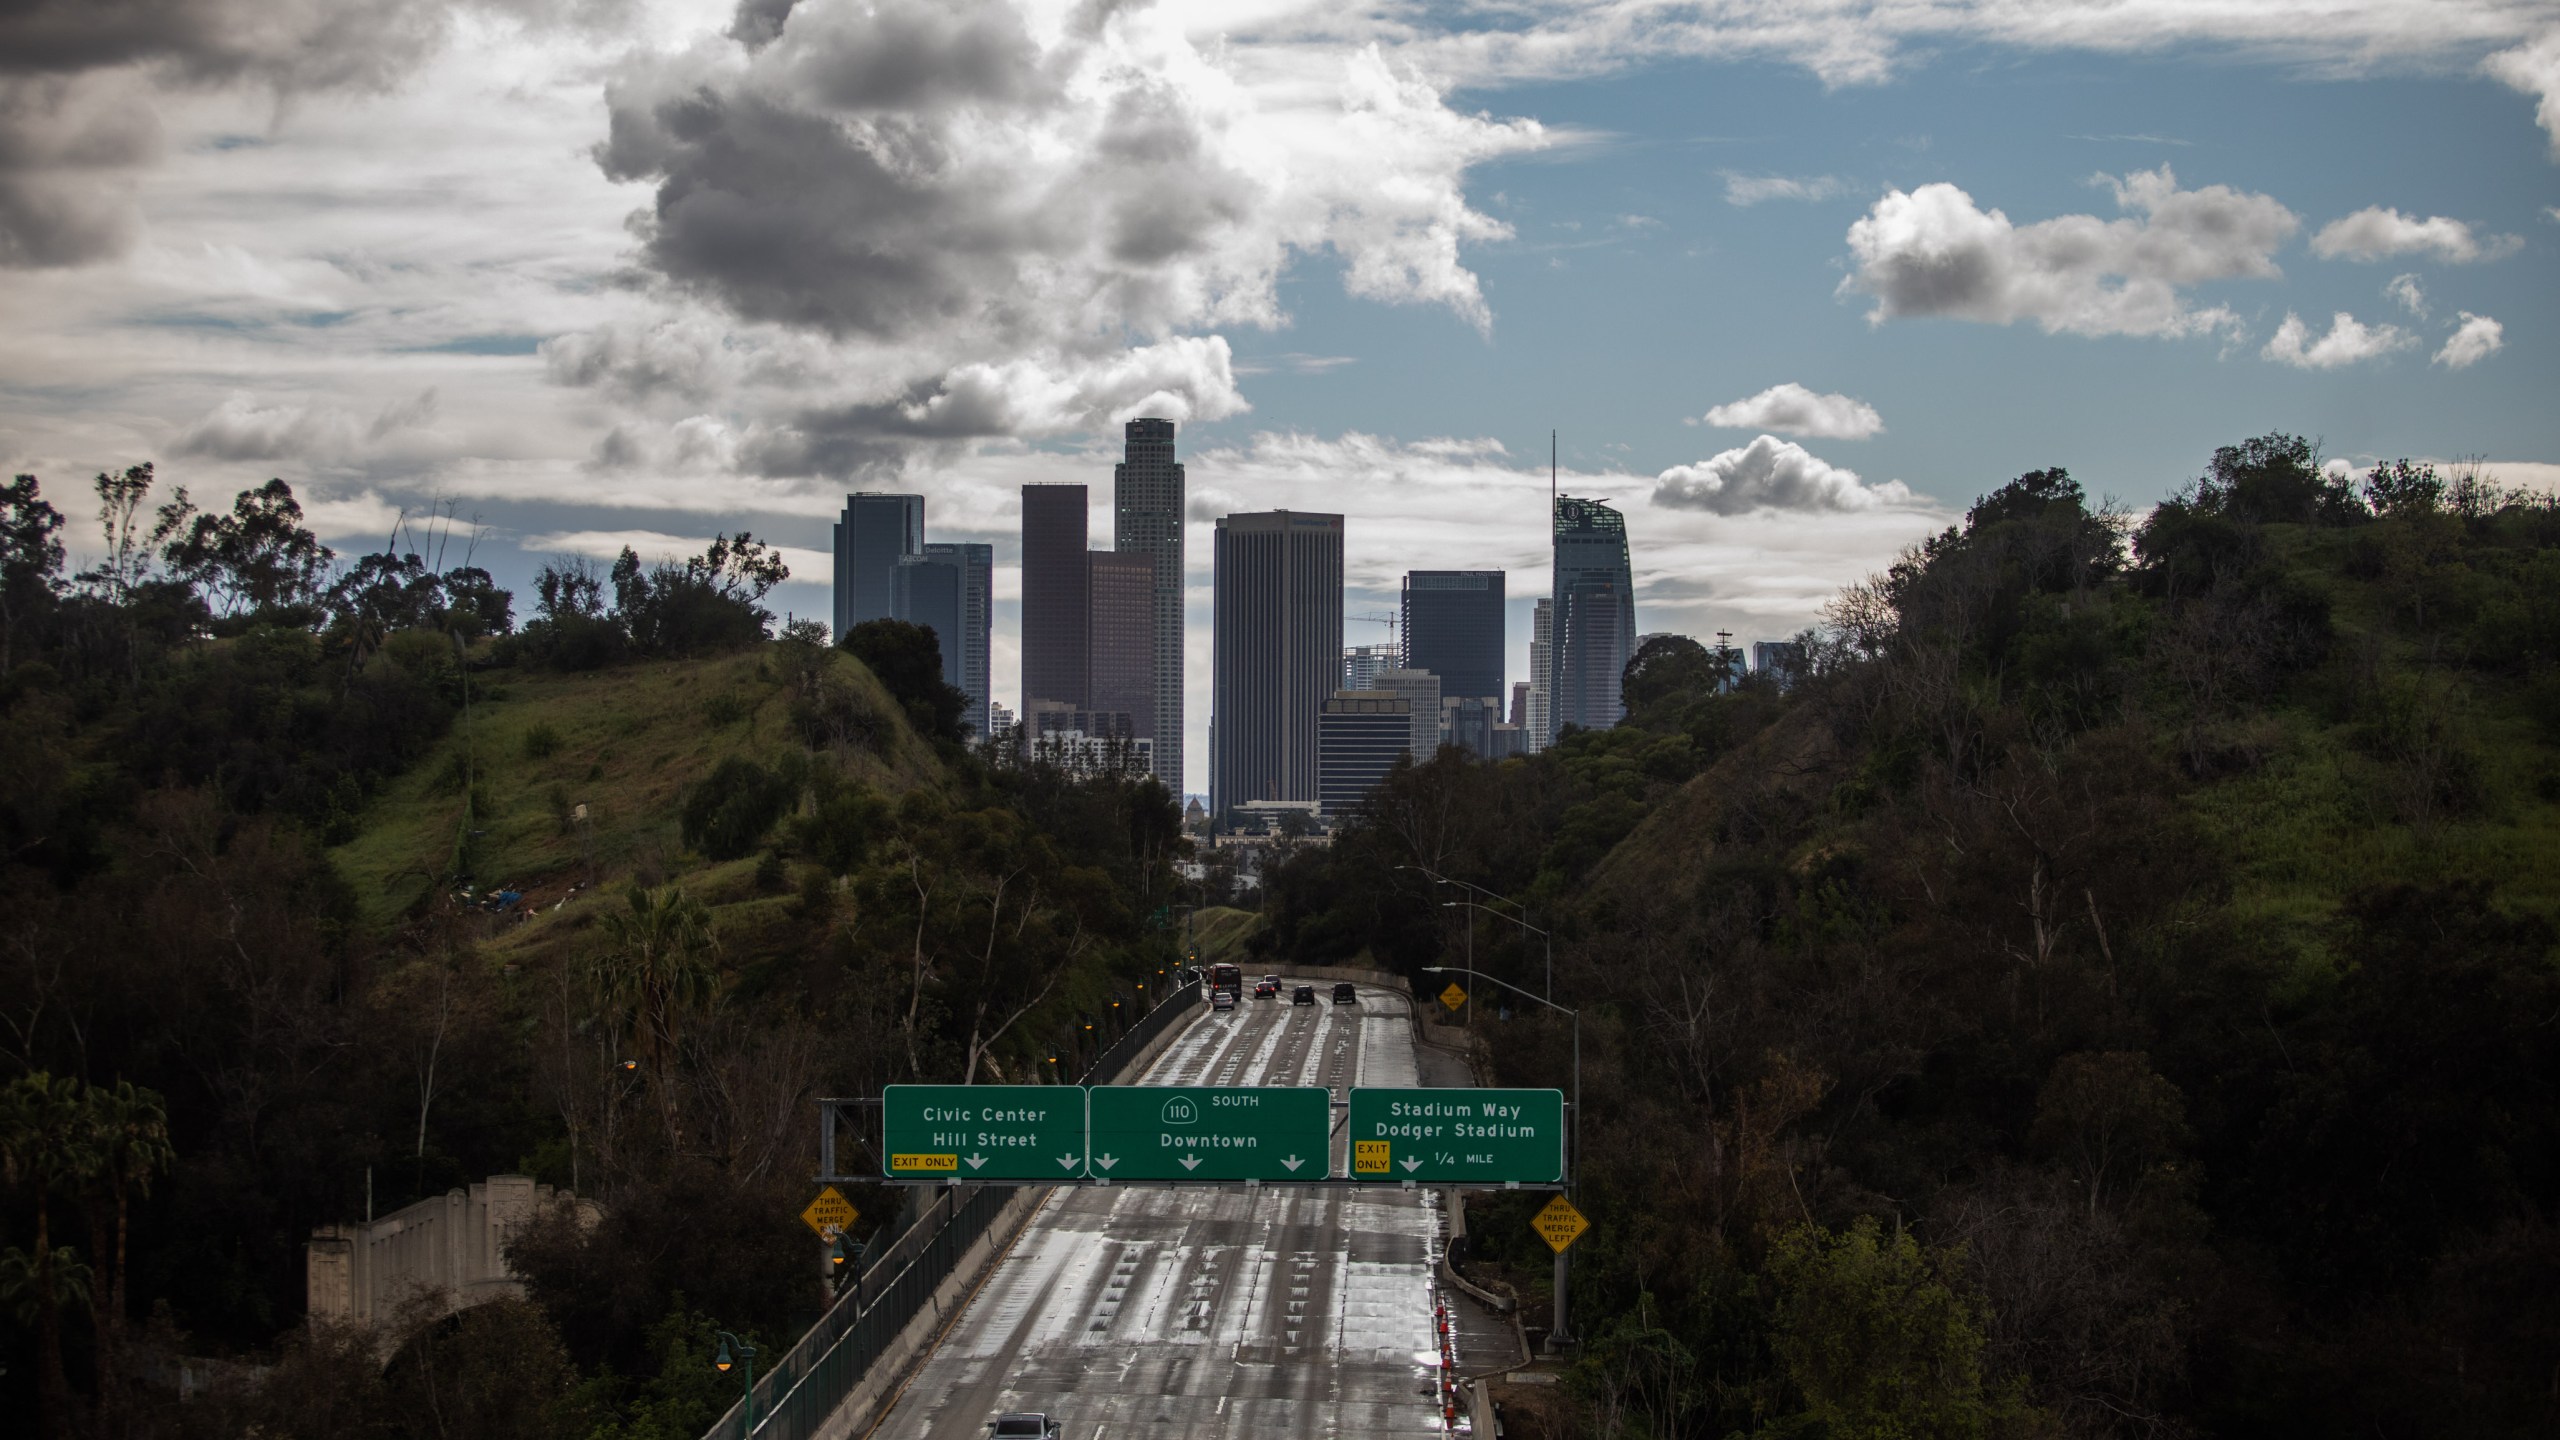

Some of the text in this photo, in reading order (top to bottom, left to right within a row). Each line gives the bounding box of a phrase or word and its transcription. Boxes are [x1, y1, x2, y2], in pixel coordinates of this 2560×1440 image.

[925, 546, 954, 554] Deloitte
[1212, 1096, 1259, 1107] SOUTH
[923, 1107, 1046, 1122] Civic Center
[1170, 1105, 1190, 1118] 110
[1391, 1102, 1521, 1120] Stadium Way
[1376, 1122, 1535, 1140] Dodger Stadium
[933, 1132, 1037, 1147] Hill Street
[1161, 1133, 1257, 1148] Downtown
[1358, 1144, 1387, 1154] EXIT
[893, 1157, 955, 1167] EXIT ONLY
[1466, 1154, 1494, 1164] MILE
[1357, 1160, 1387, 1169] ONLY
[814, 1206, 848, 1214] TRAFFIC
[1550, 1204, 1571, 1212] THRU
[817, 1216, 844, 1224] MERGE
[1543, 1214, 1577, 1222] TRAFFIC
[1544, 1224, 1576, 1232] MERGE
[1549, 1234, 1571, 1242] LEFT
